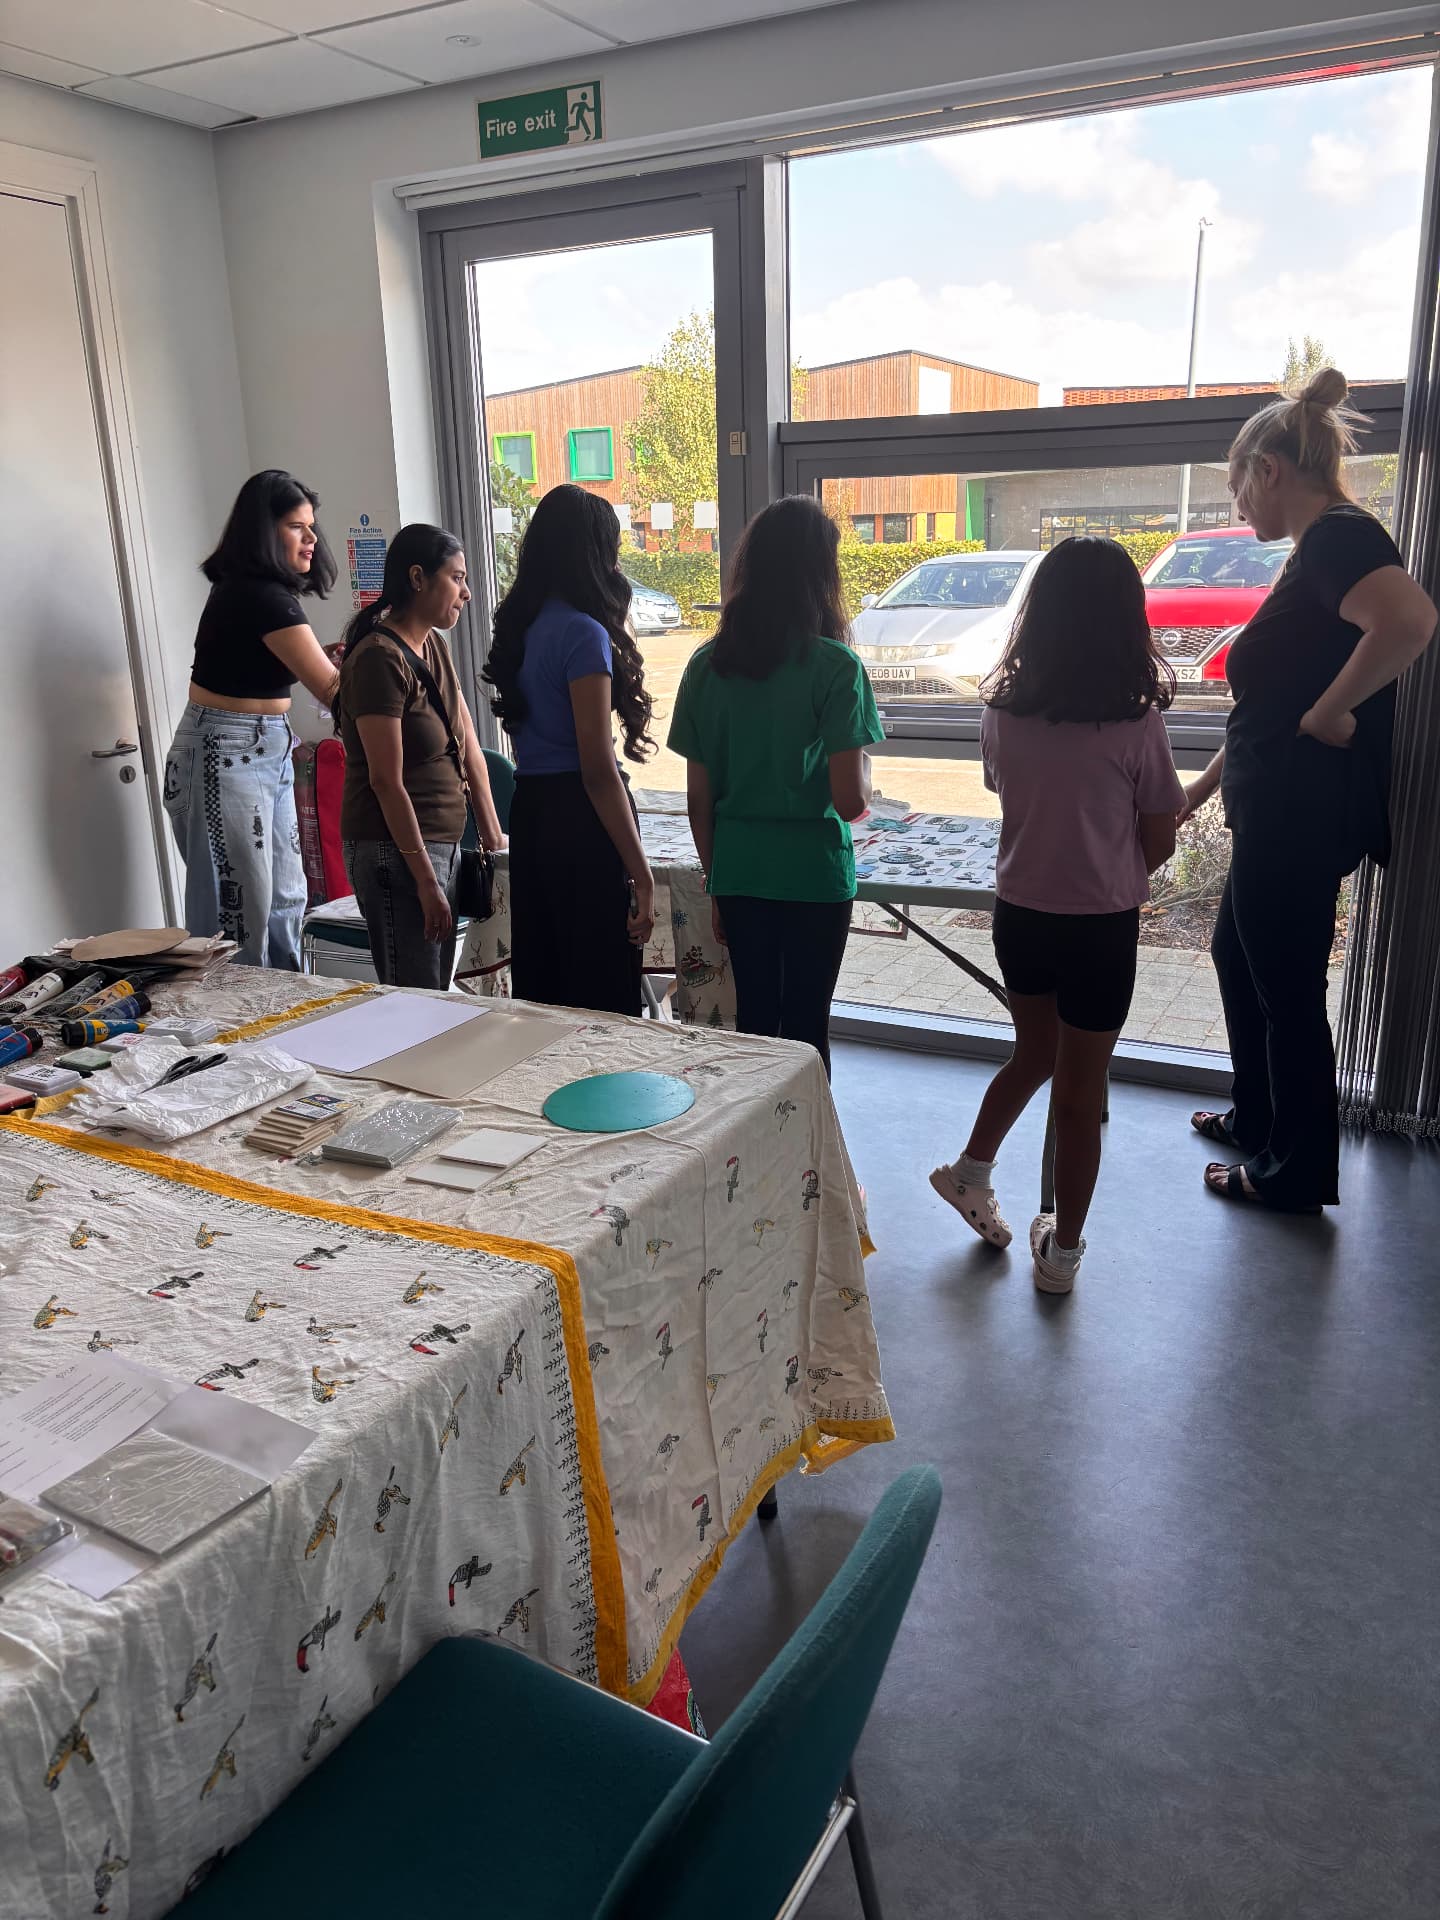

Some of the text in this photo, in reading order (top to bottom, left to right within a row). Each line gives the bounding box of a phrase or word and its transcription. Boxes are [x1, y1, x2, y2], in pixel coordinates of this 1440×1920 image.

[485, 109, 557, 139] Fire exit
[892, 668, 911, 679] UAV
